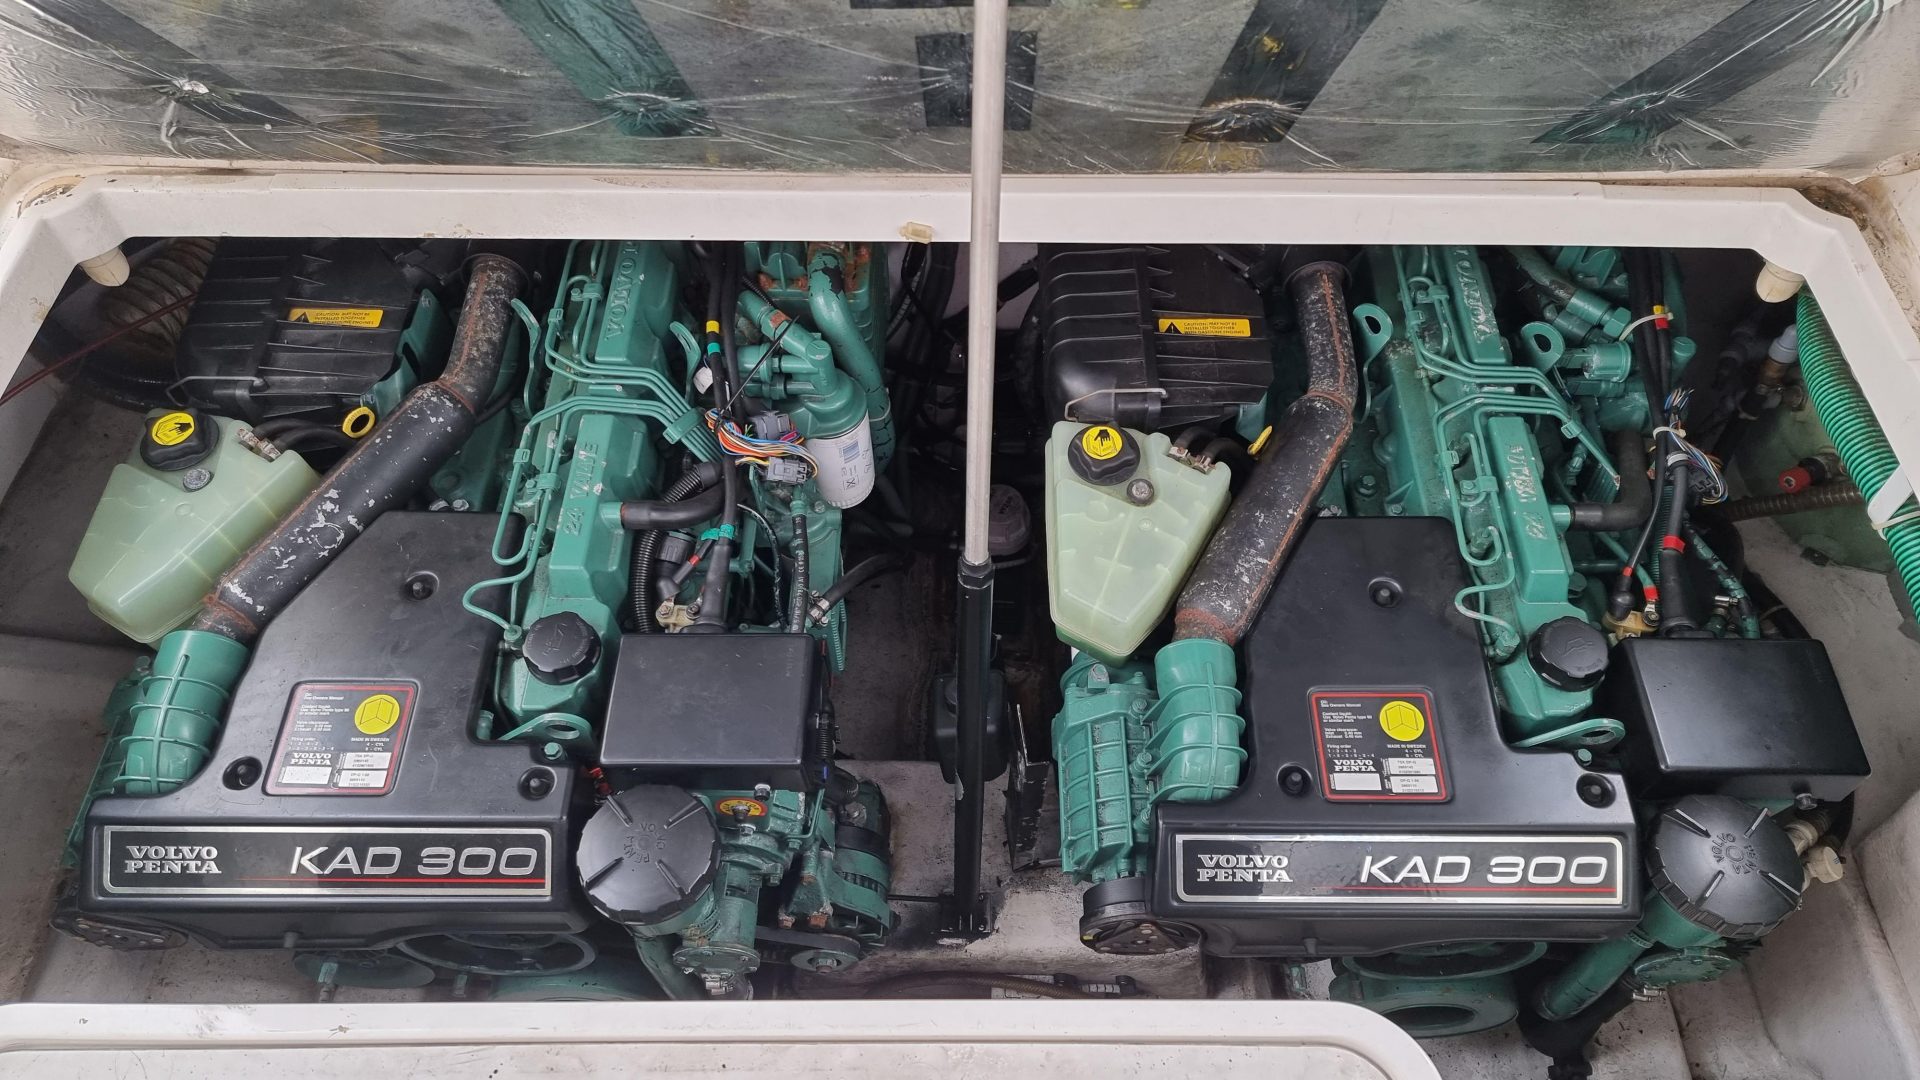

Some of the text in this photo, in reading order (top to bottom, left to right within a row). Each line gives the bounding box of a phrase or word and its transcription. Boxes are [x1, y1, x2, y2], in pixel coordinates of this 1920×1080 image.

[605, 258, 636, 341] VOLVO
[640, 823, 666, 849] VOLVO
[1712, 833, 1736, 863] VOLVO
[124, 860, 222, 874] PENTA
[125, 845, 538, 875] VOLVO KAD 300
[1196, 868, 1293, 882] PENTA
[1197, 854, 1608, 885] VOLVO KAD 300
